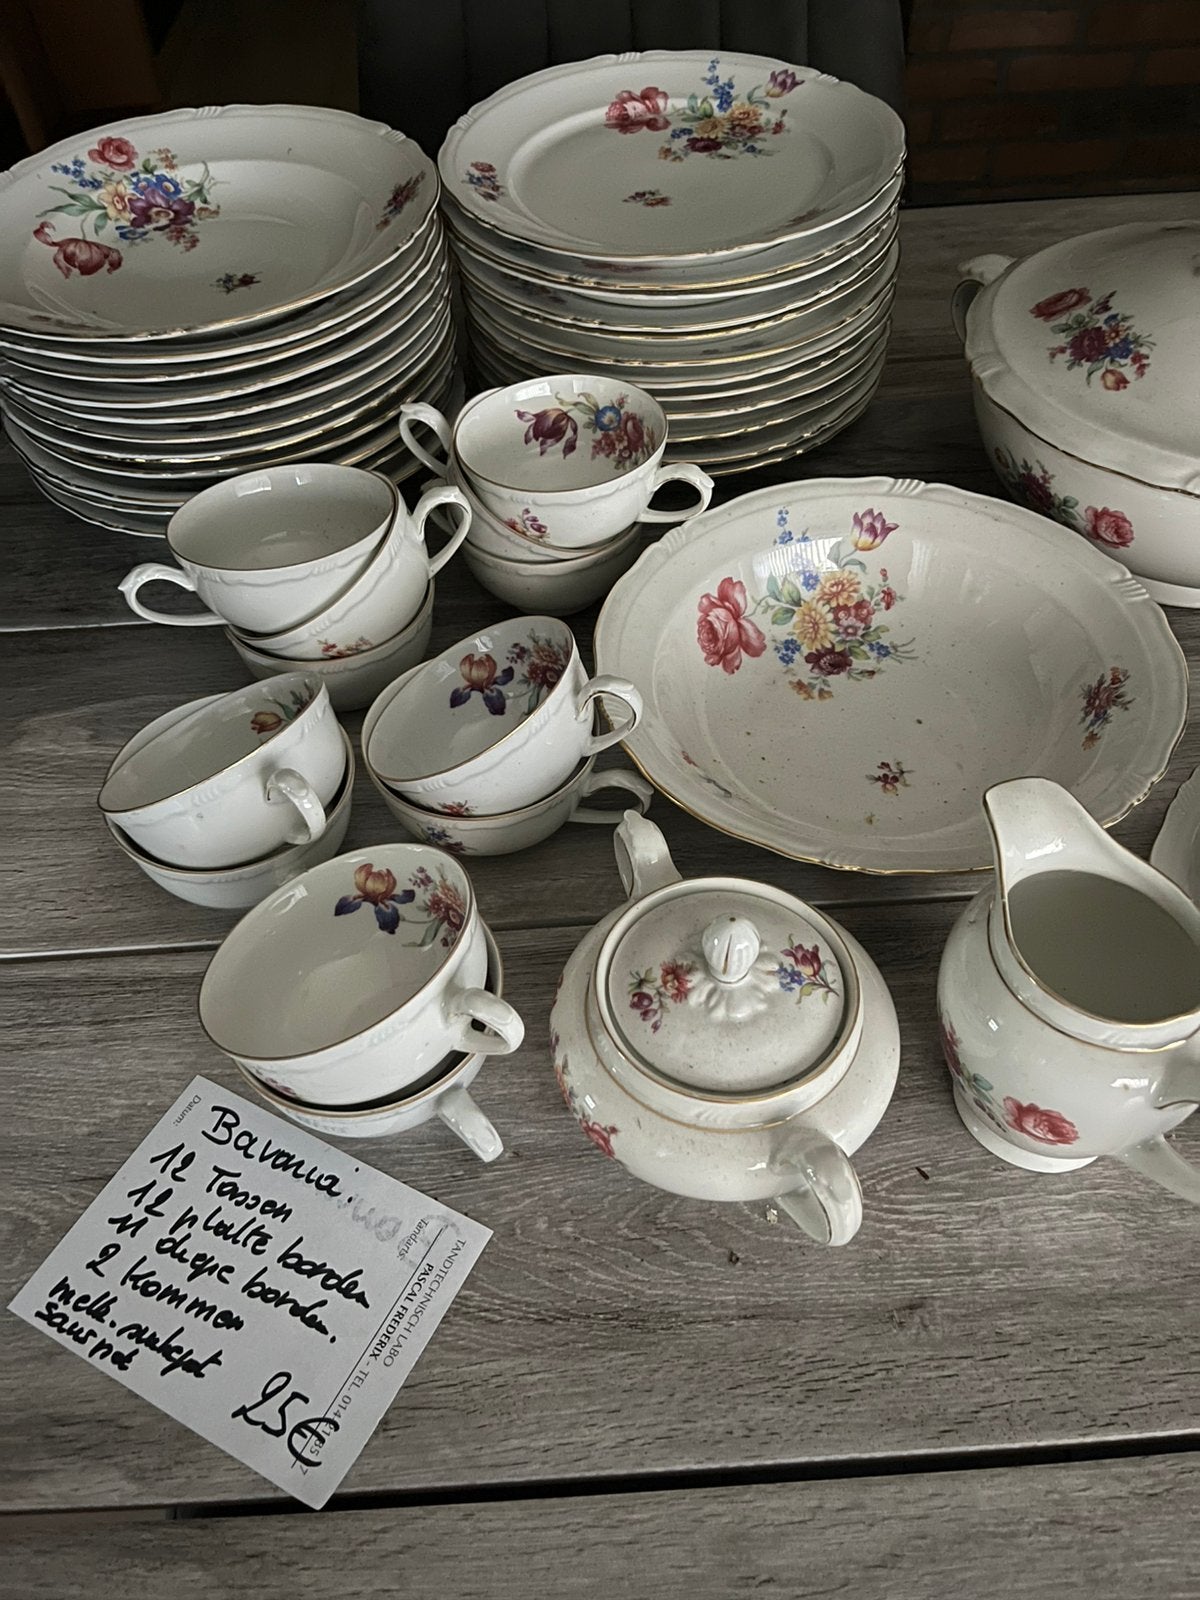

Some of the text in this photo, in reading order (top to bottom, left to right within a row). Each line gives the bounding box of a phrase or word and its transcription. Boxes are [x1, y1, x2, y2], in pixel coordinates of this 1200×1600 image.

[173, 1094, 202, 1127] Datum:
[150, 1142, 196, 1182] 12
[108, 1213, 149, 1239] 11
[127, 1179, 173, 1217] 12
[276, 1236, 369, 1309] borden
[86, 1243, 121, 1278] 2
[404, 1262, 435, 1303] PASCAL
[382, 1239, 467, 1368] TANDTECHNISCH LABO
[368, 1304, 410, 1361] FREDERIX
[347, 1370, 370, 1391] TEL.
